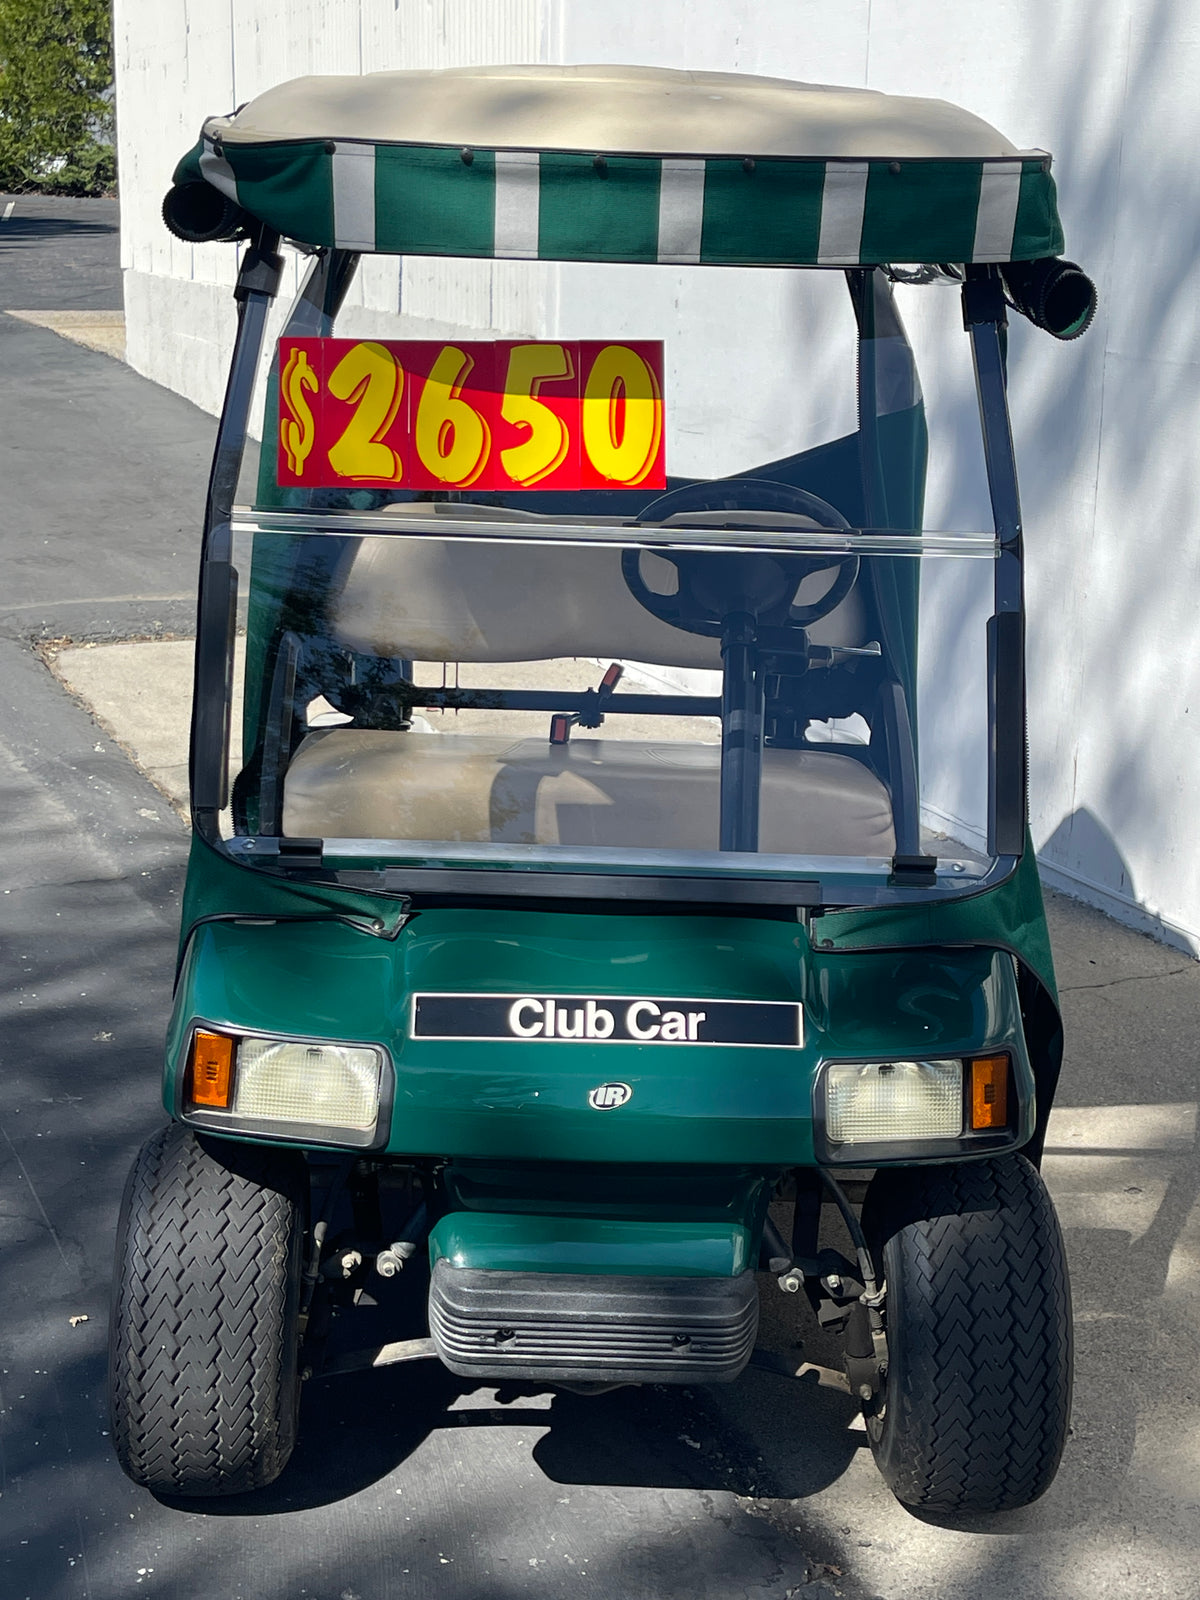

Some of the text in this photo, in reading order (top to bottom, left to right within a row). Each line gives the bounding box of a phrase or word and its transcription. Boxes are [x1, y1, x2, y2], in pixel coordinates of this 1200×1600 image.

[280, 342, 662, 487] $2650
[508, 998, 706, 1040] Club Car
[595, 1087, 626, 1105] IR
